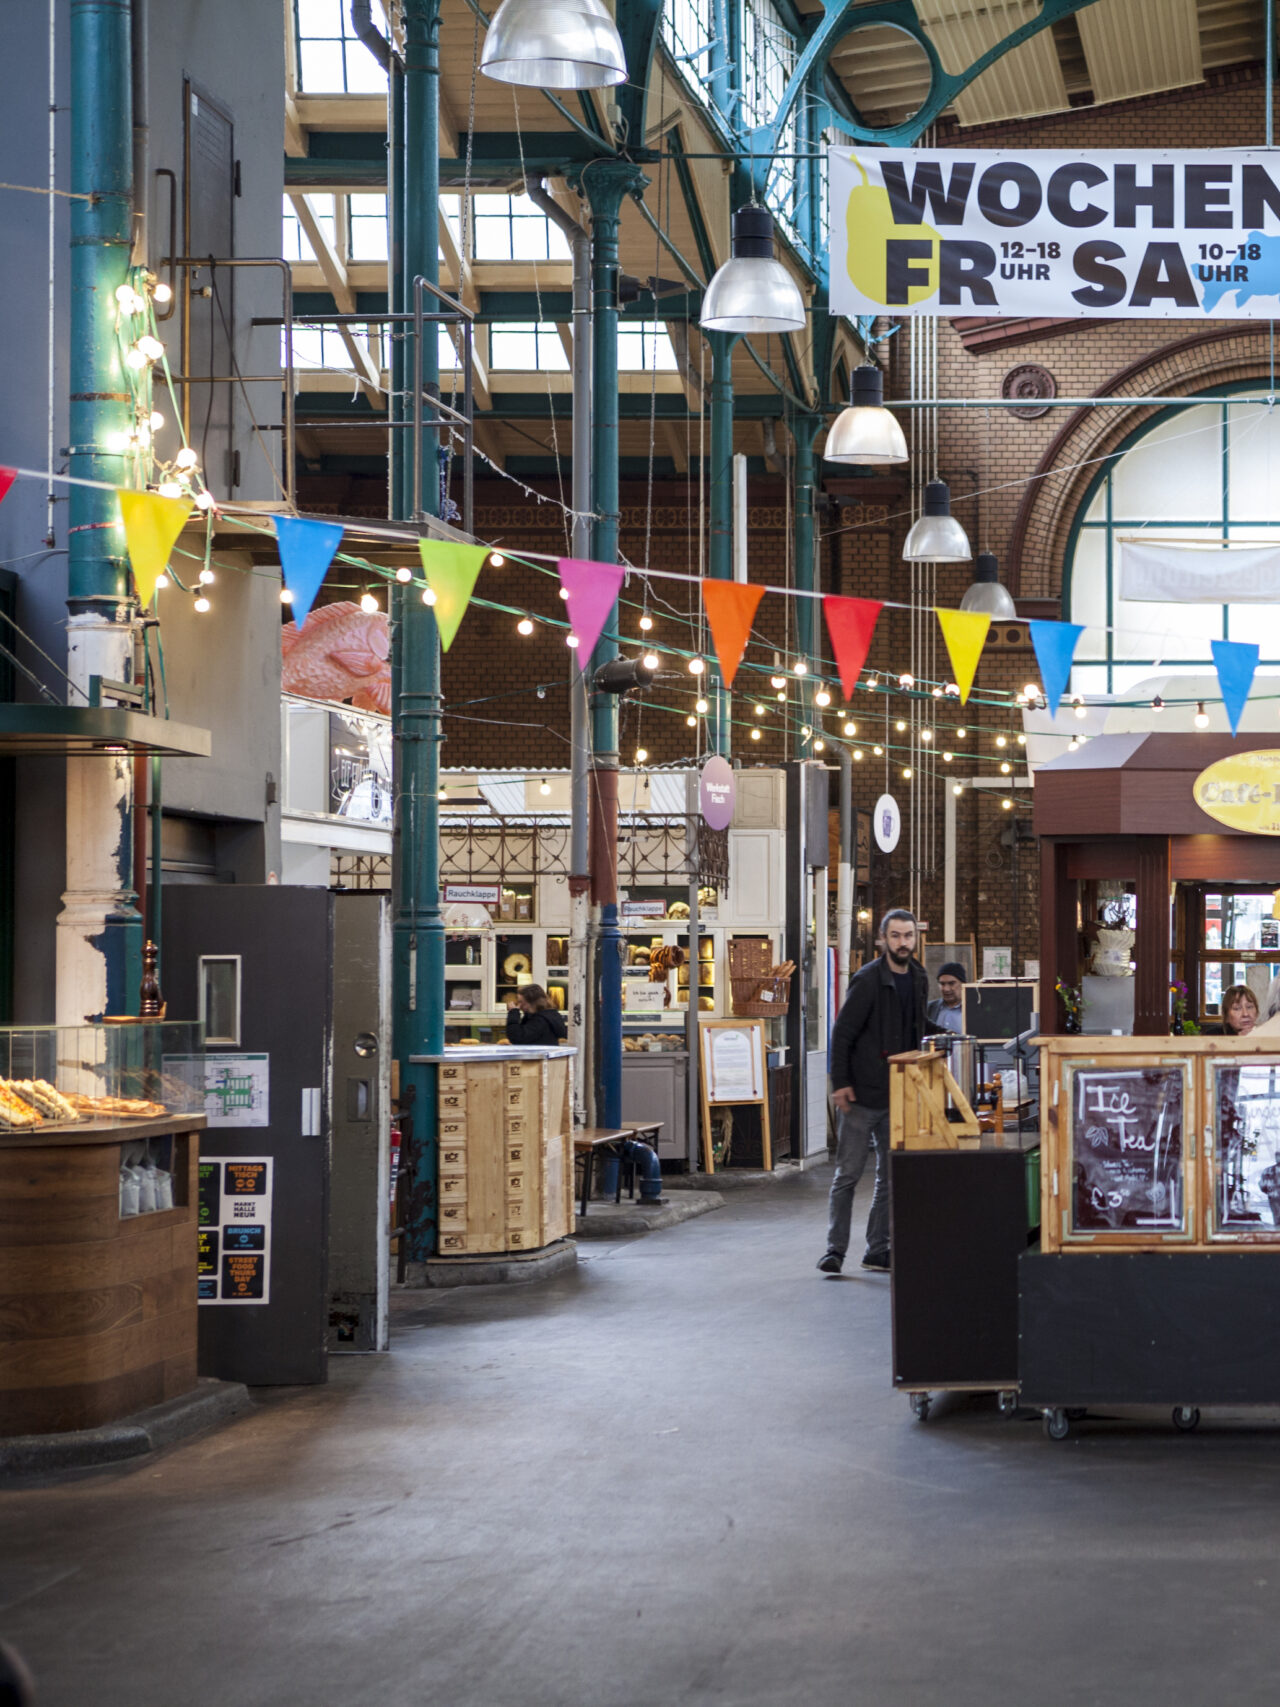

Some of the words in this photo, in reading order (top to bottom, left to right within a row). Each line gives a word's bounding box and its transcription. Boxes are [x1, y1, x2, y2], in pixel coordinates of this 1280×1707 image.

[1000, 242, 1061, 259] 12-18
[1199, 243, 1262, 261] 10-18
[885, 238, 999, 306] FR
[1000, 264, 1051, 281] UHR
[1071, 239, 1200, 308] SA
[1198, 265, 1249, 282] UHR
[448, 889, 496, 899] Rauchklappe
[1086, 1085, 1137, 1113] Ice
[1106, 1116, 1156, 1153] Tea
